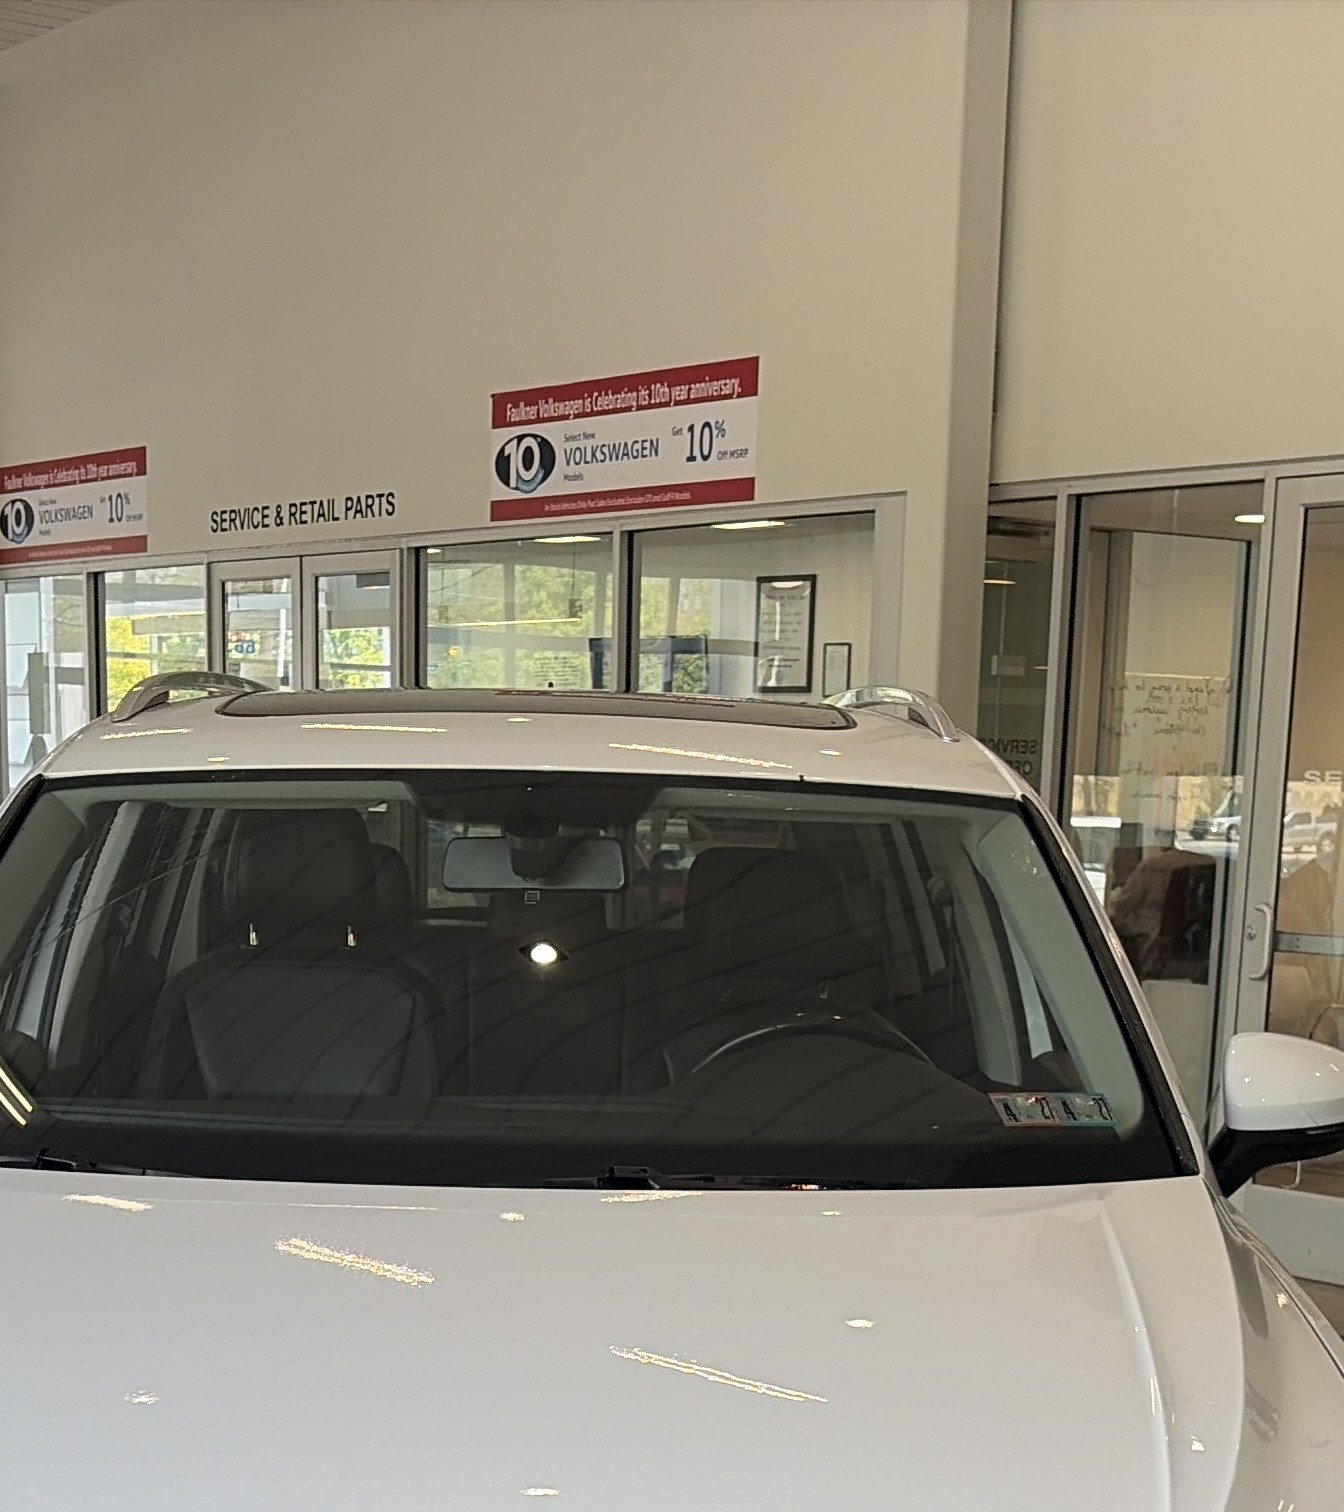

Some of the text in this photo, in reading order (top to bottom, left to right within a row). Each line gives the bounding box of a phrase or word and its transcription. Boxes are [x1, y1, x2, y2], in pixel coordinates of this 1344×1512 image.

[506, 402, 538, 422] Faulkner
[539, 397, 583, 420] Volkswagen
[584, 393, 592, 413] is
[592, 387, 637, 411] Celebrating
[650, 381, 670, 403] 10th
[670, 384, 689, 407] year
[671, 426, 683, 437] Get
[563, 437, 659, 467] VOLKSWAGEN
[39, 505, 94, 524] VOLKSWAGEN
[210, 491, 396, 533] SERVICE & RETAIL PARTS
